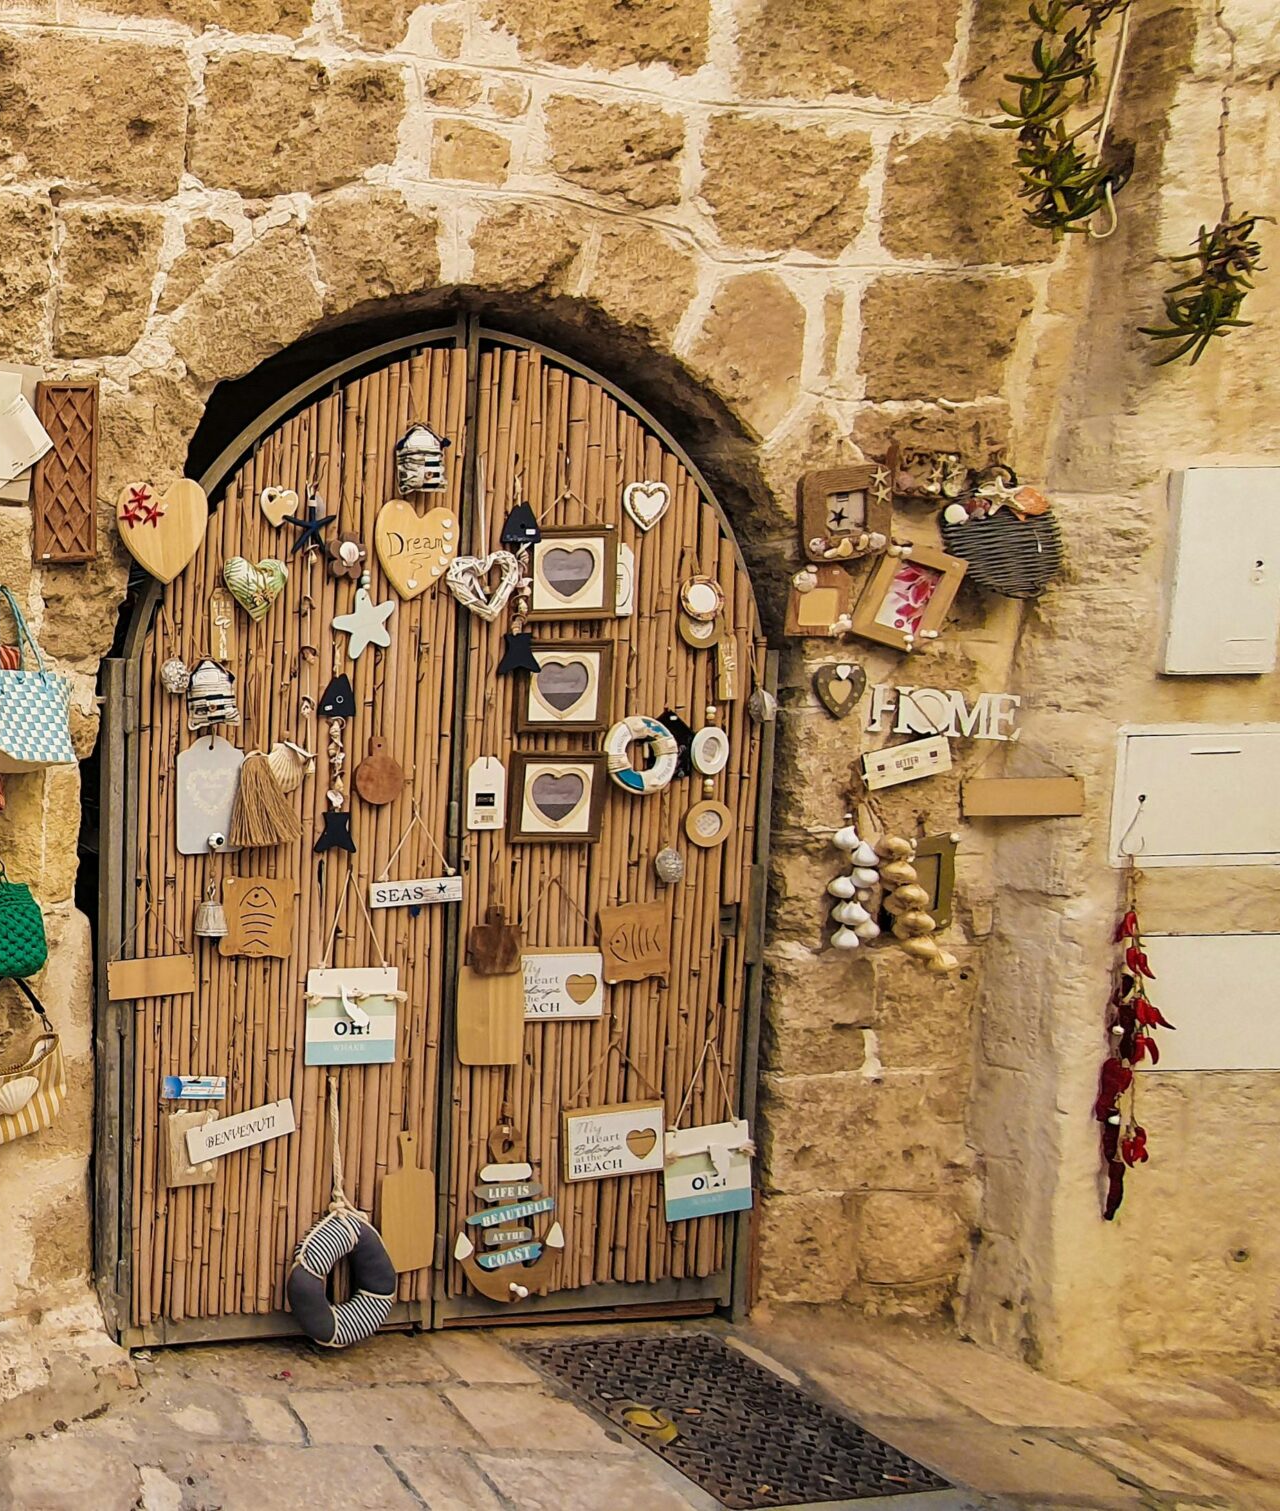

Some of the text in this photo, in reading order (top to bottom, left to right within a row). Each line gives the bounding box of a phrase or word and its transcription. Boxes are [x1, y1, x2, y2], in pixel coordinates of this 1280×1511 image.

[386, 532, 442, 558] Dream
[867, 684, 1022, 741] HOME
[895, 756, 919, 769] BETTER
[376, 887, 424, 903] SEAS
[524, 976, 560, 985] Heart
[205, 1115, 276, 1149] BENVENUTI
[586, 1133, 620, 1144] Heart
[574, 1159, 623, 1174] BEACH
[488, 1185, 530, 1199] LIFE IS
[482, 1200, 551, 1227] BEAUTIFUL
[492, 1231, 525, 1241] AT THE
[487, 1246, 531, 1268] COAST
